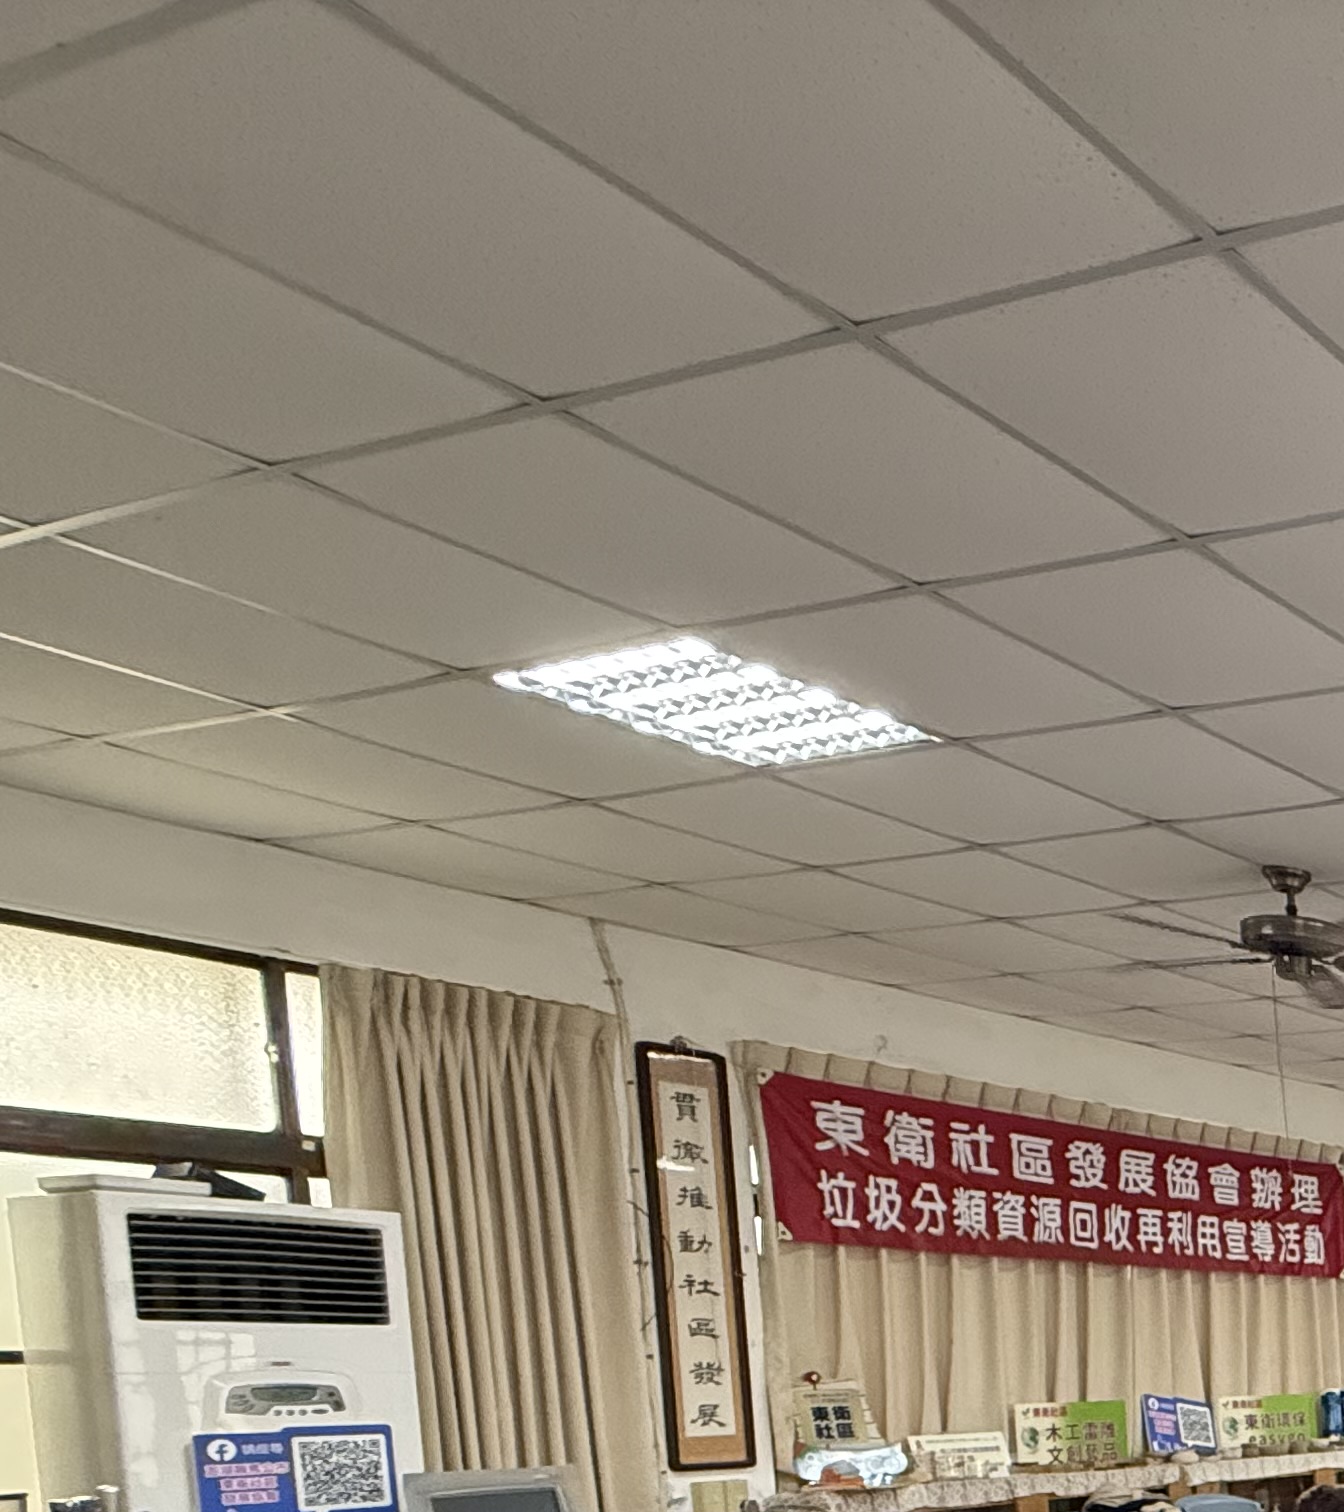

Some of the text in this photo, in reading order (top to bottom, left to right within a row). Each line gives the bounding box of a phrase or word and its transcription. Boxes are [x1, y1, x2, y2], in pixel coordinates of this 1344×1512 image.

[811, 1100, 1323, 1214] 東衛社區發展協會辦理
[670, 1091, 726, 1428] 貫徹推動社區發展
[818, 1169, 1325, 1265] 垃圾分類資源回收再利用宣導活動
